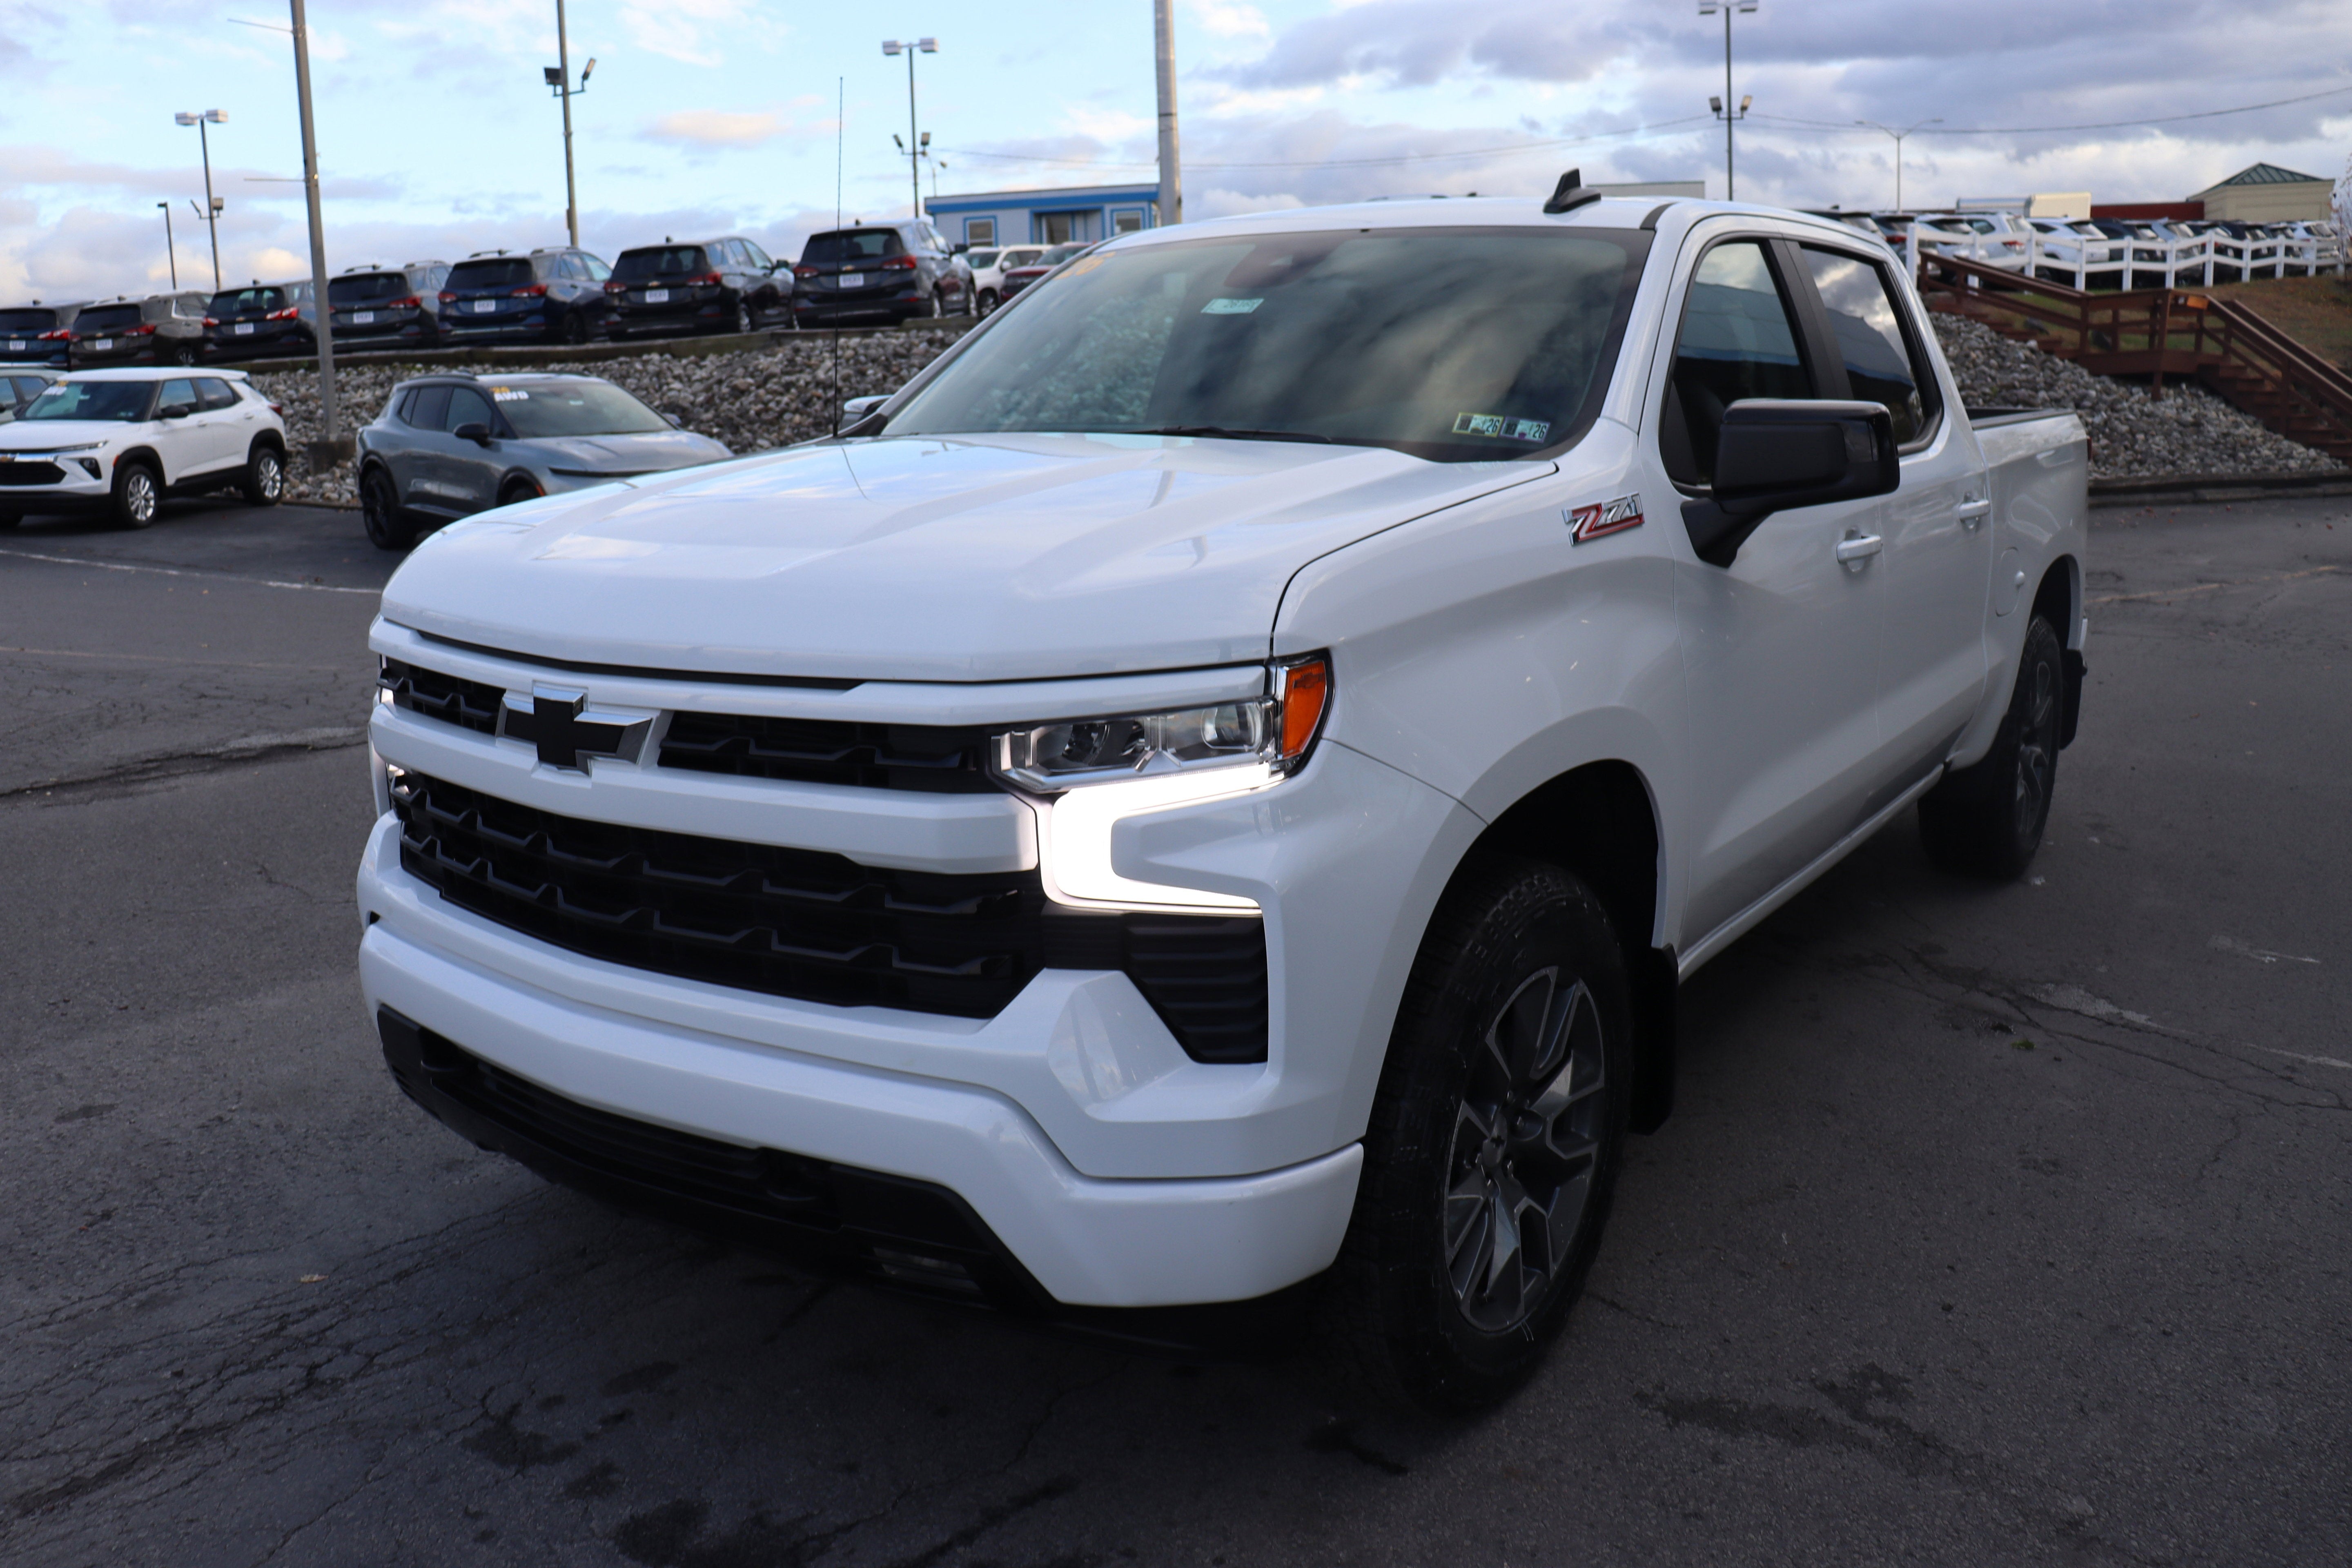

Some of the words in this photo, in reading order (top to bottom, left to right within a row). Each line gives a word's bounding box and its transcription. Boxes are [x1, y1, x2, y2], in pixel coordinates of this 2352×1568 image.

[1486, 418, 1500, 433] 26
[1532, 424, 1546, 439] 26
[1562, 491, 1645, 545] Z71
